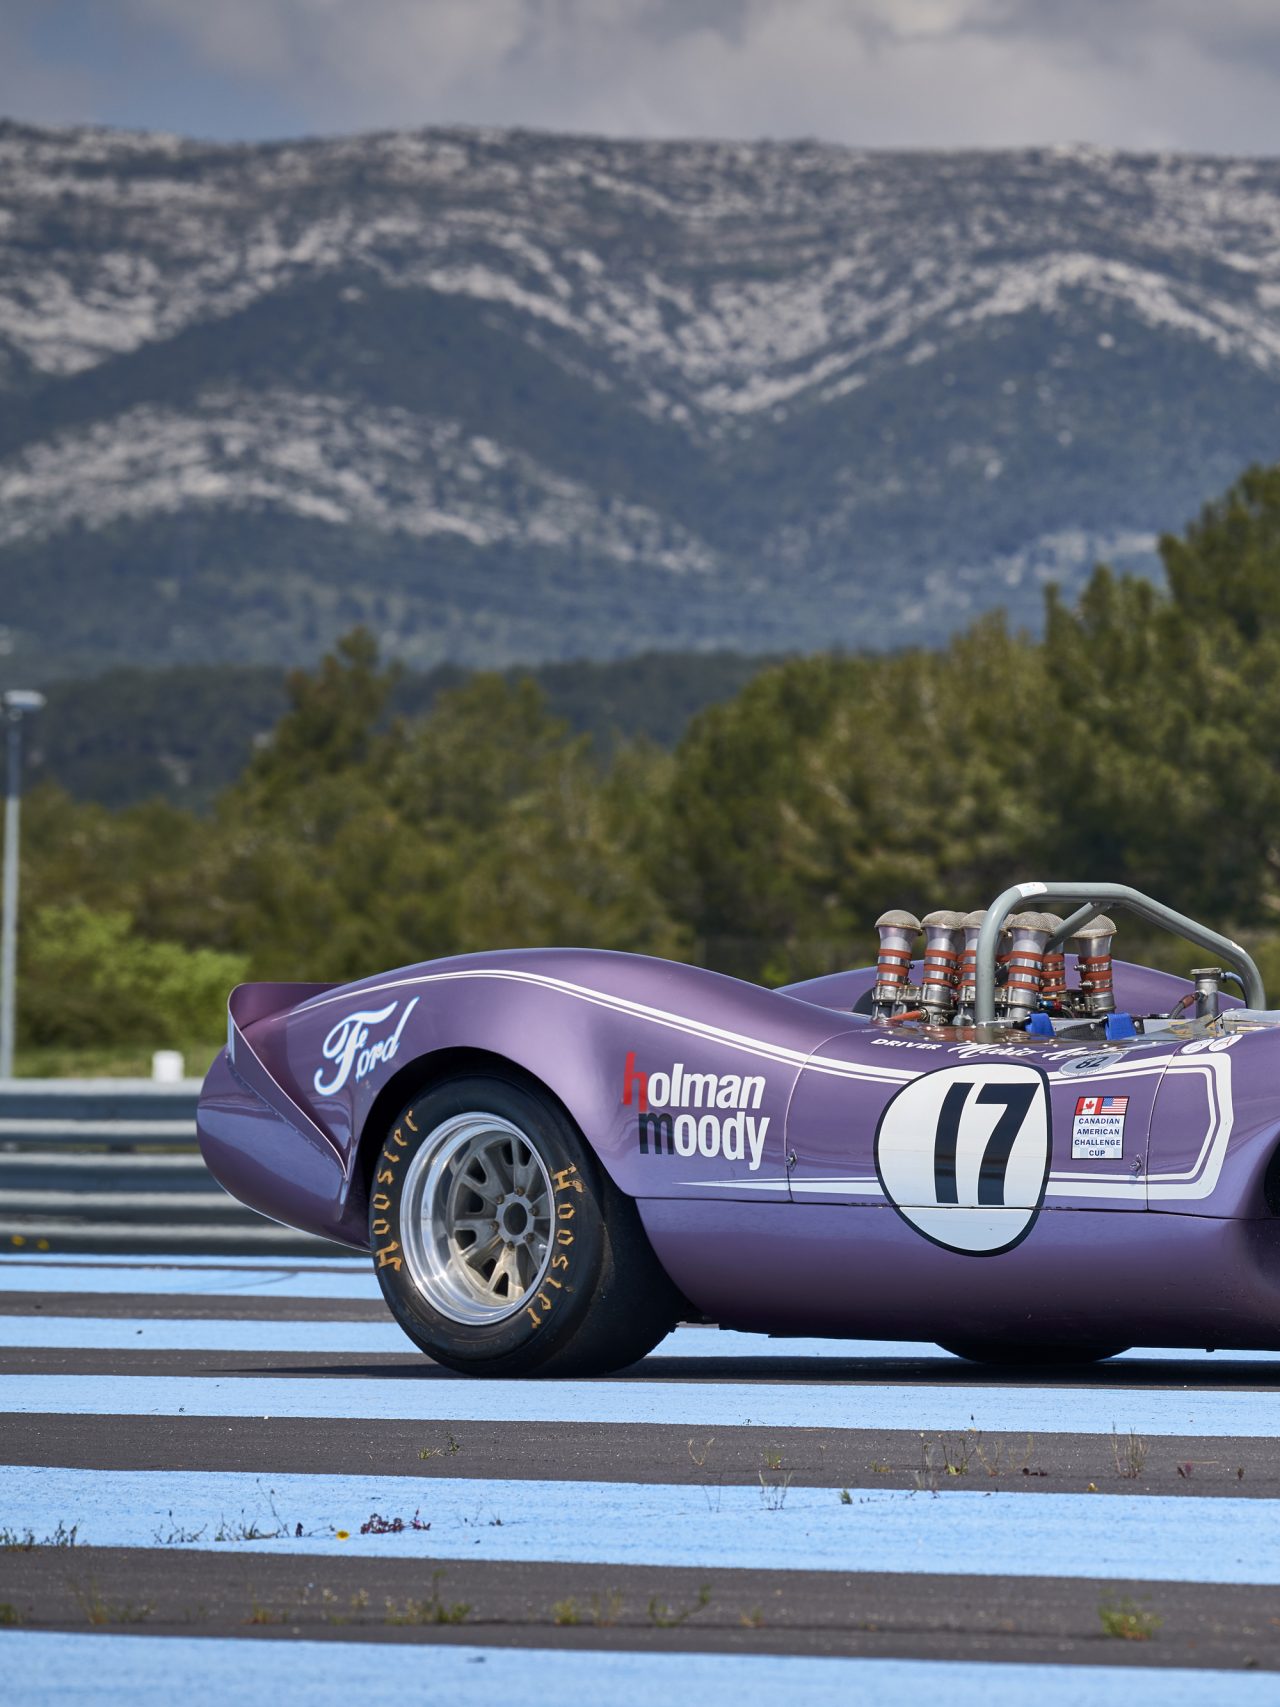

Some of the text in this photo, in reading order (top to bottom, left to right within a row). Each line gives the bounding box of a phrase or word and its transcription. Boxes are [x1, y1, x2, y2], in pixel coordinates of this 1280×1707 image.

[313, 996, 420, 1096] Ford
[622, 1051, 766, 1112] holman
[870, 1038, 943, 1050] DRIVER
[638, 1111, 771, 1171] moody
[933, 1081, 1041, 1206] 17
[1088, 1149, 1106, 1157] CUP
[372, 1109, 420, 1272] Hoosier
[527, 1160, 586, 1328] Hoosier
